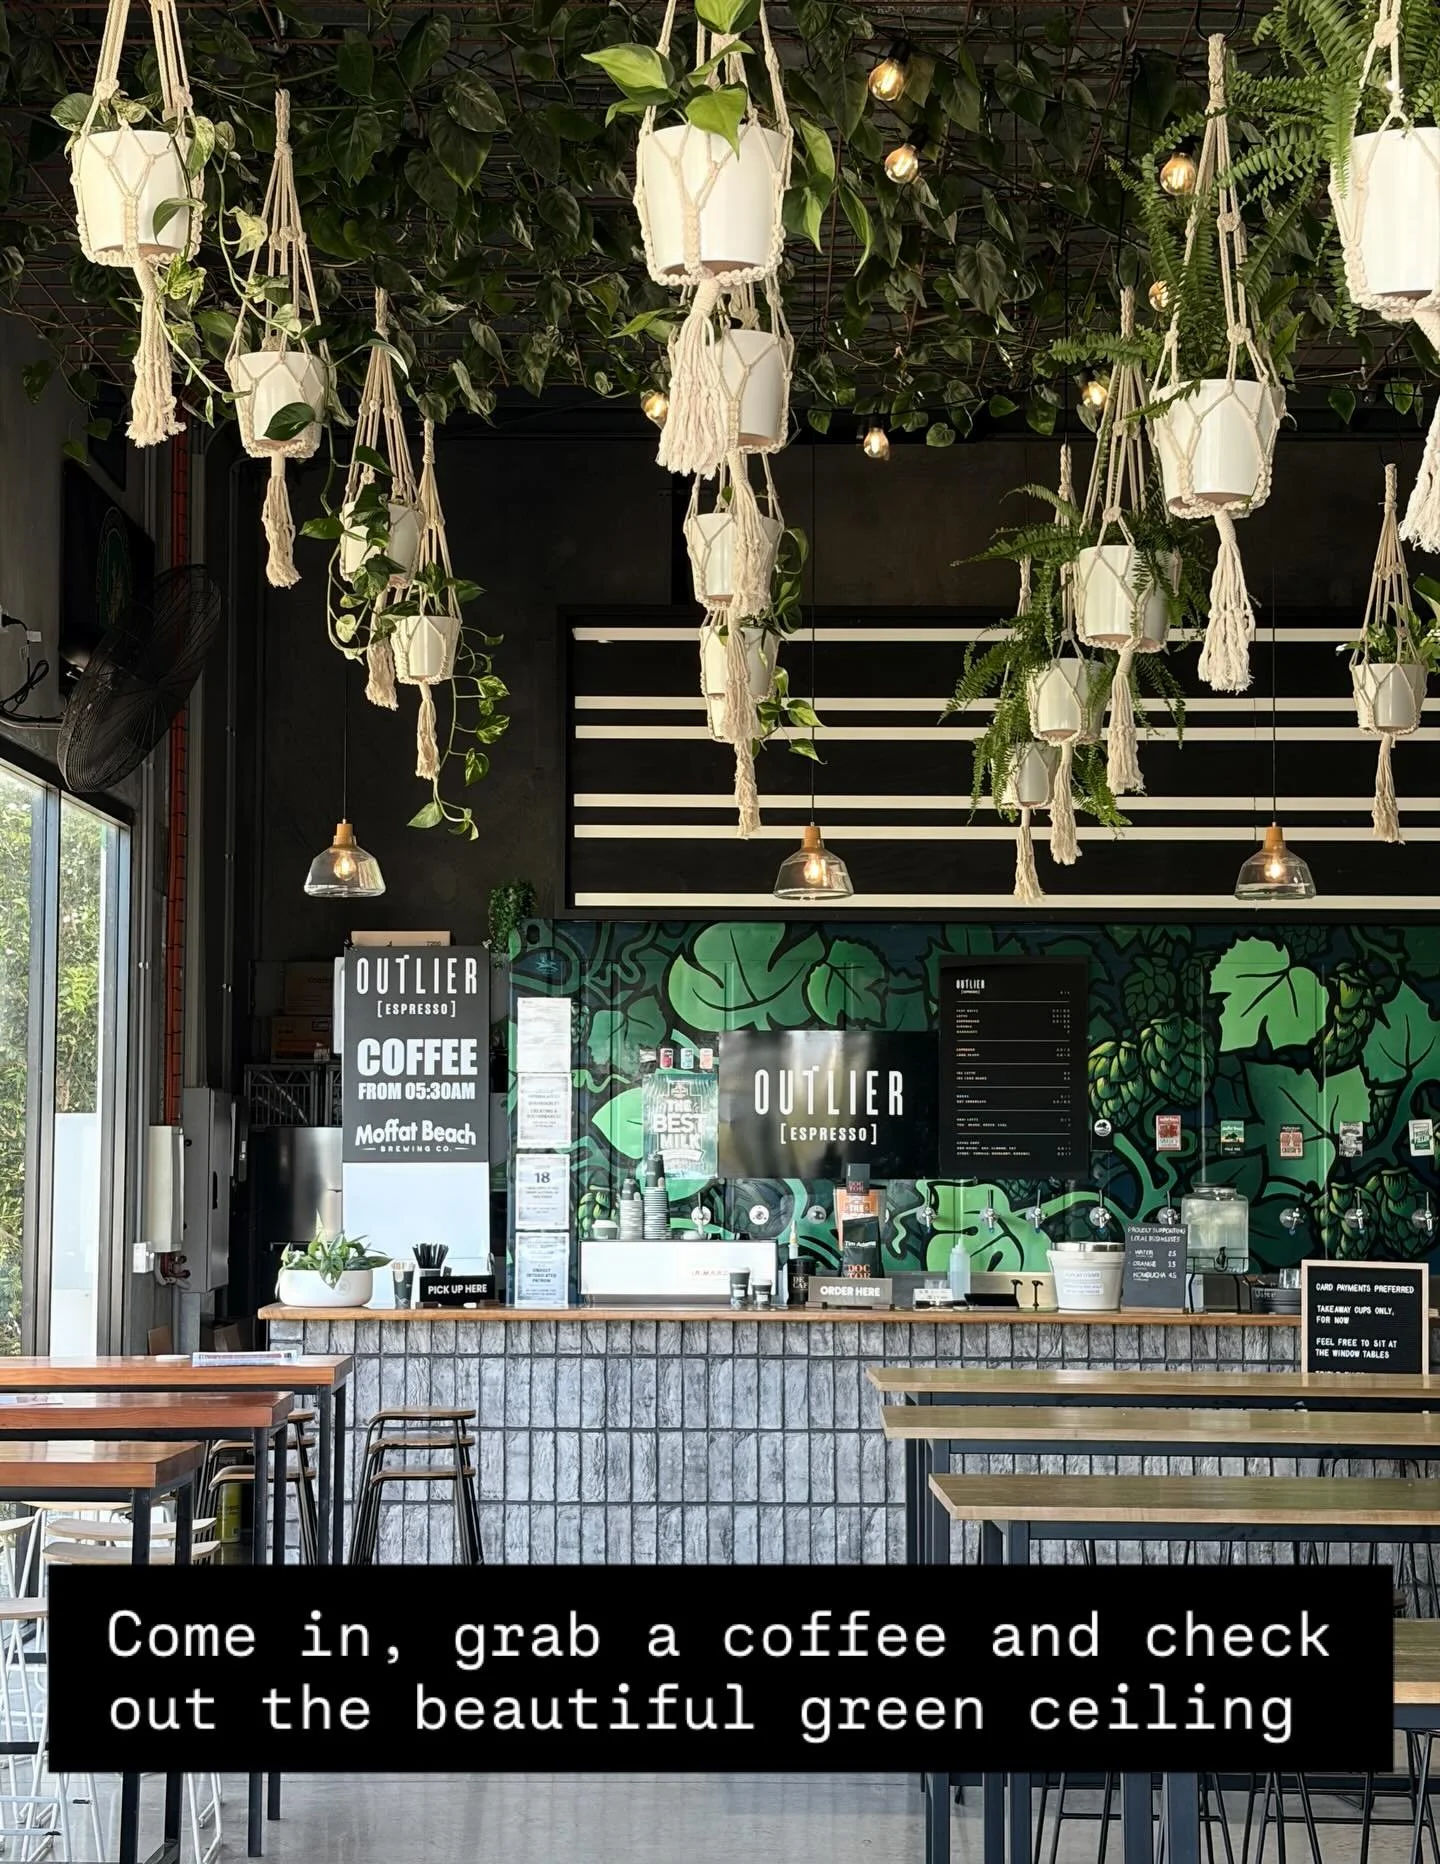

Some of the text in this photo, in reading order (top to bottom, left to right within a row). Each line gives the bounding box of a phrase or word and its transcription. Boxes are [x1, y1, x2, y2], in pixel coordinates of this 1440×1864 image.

[356, 954, 477, 995] OUTLIER
[357, 1038, 478, 1076] COFFEE
[358, 1081, 476, 1101] FROM 05:30AM
[754, 1065, 904, 1116] OUTLIER
[653, 1113, 706, 1133] BEST
[354, 1118, 476, 1146] Moffat Beach
[380, 1145, 431, 1153] BREWING
[534, 1172, 551, 1184] 18
[427, 1283, 487, 1295] PICK UP HERE
[819, 1285, 881, 1297] ORDER HERE
[1315, 1282, 1415, 1294] CARD PAYMENTS PREFERRED
[1316, 1304, 1352, 1314] TAKEAWAY
[1353, 1305, 1372, 1315] CUPS
[1315, 1315, 1350, 1325] FOR NOW
[1315, 1337, 1398, 1348] FEEL FREE TO SIT AT
[1314, 1348, 1390, 1359] THE WINDOW TABLES
